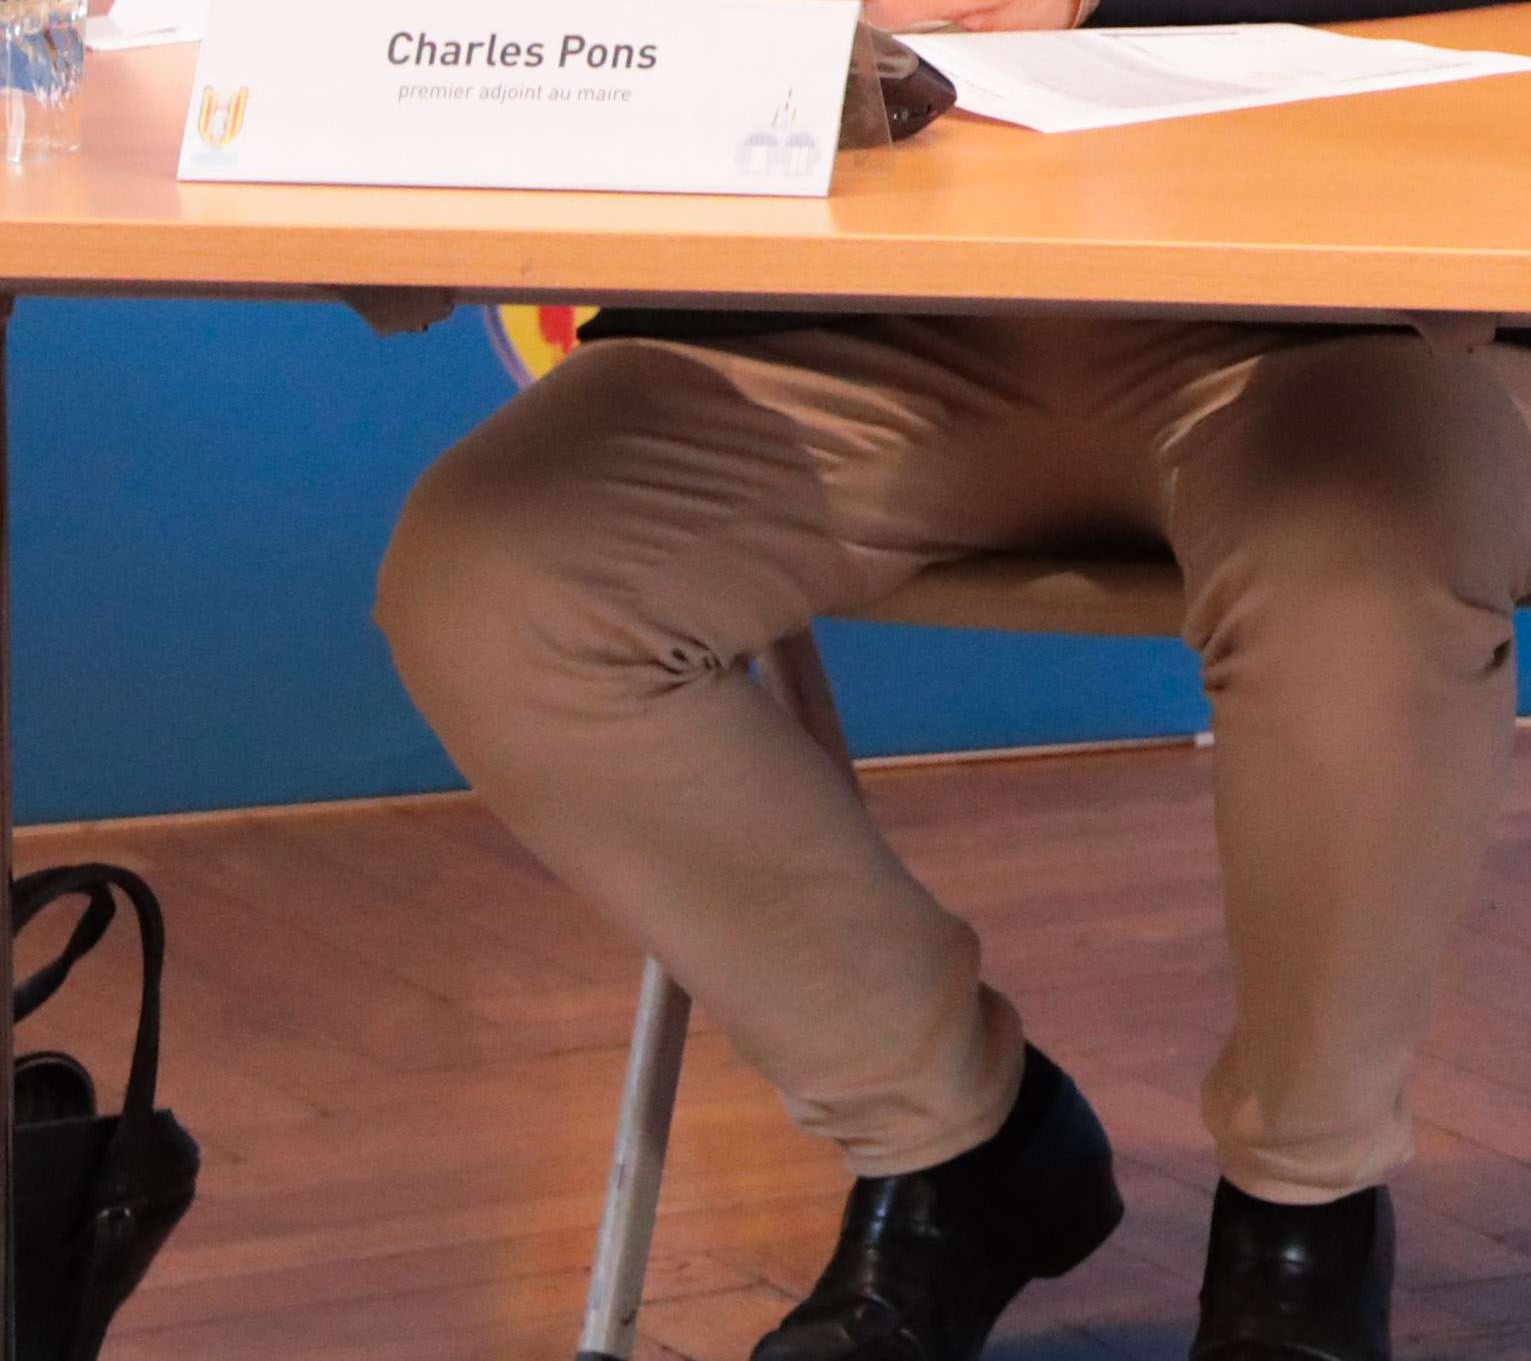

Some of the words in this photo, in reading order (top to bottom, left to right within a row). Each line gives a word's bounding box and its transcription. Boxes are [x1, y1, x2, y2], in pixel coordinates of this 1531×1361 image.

[387, 32, 543, 68] Charles
[558, 35, 657, 70] Pons
[397, 83, 473, 103] premier
[479, 82, 542, 105] adjoint
[548, 87, 571, 102] au
[577, 84, 632, 103] maire
